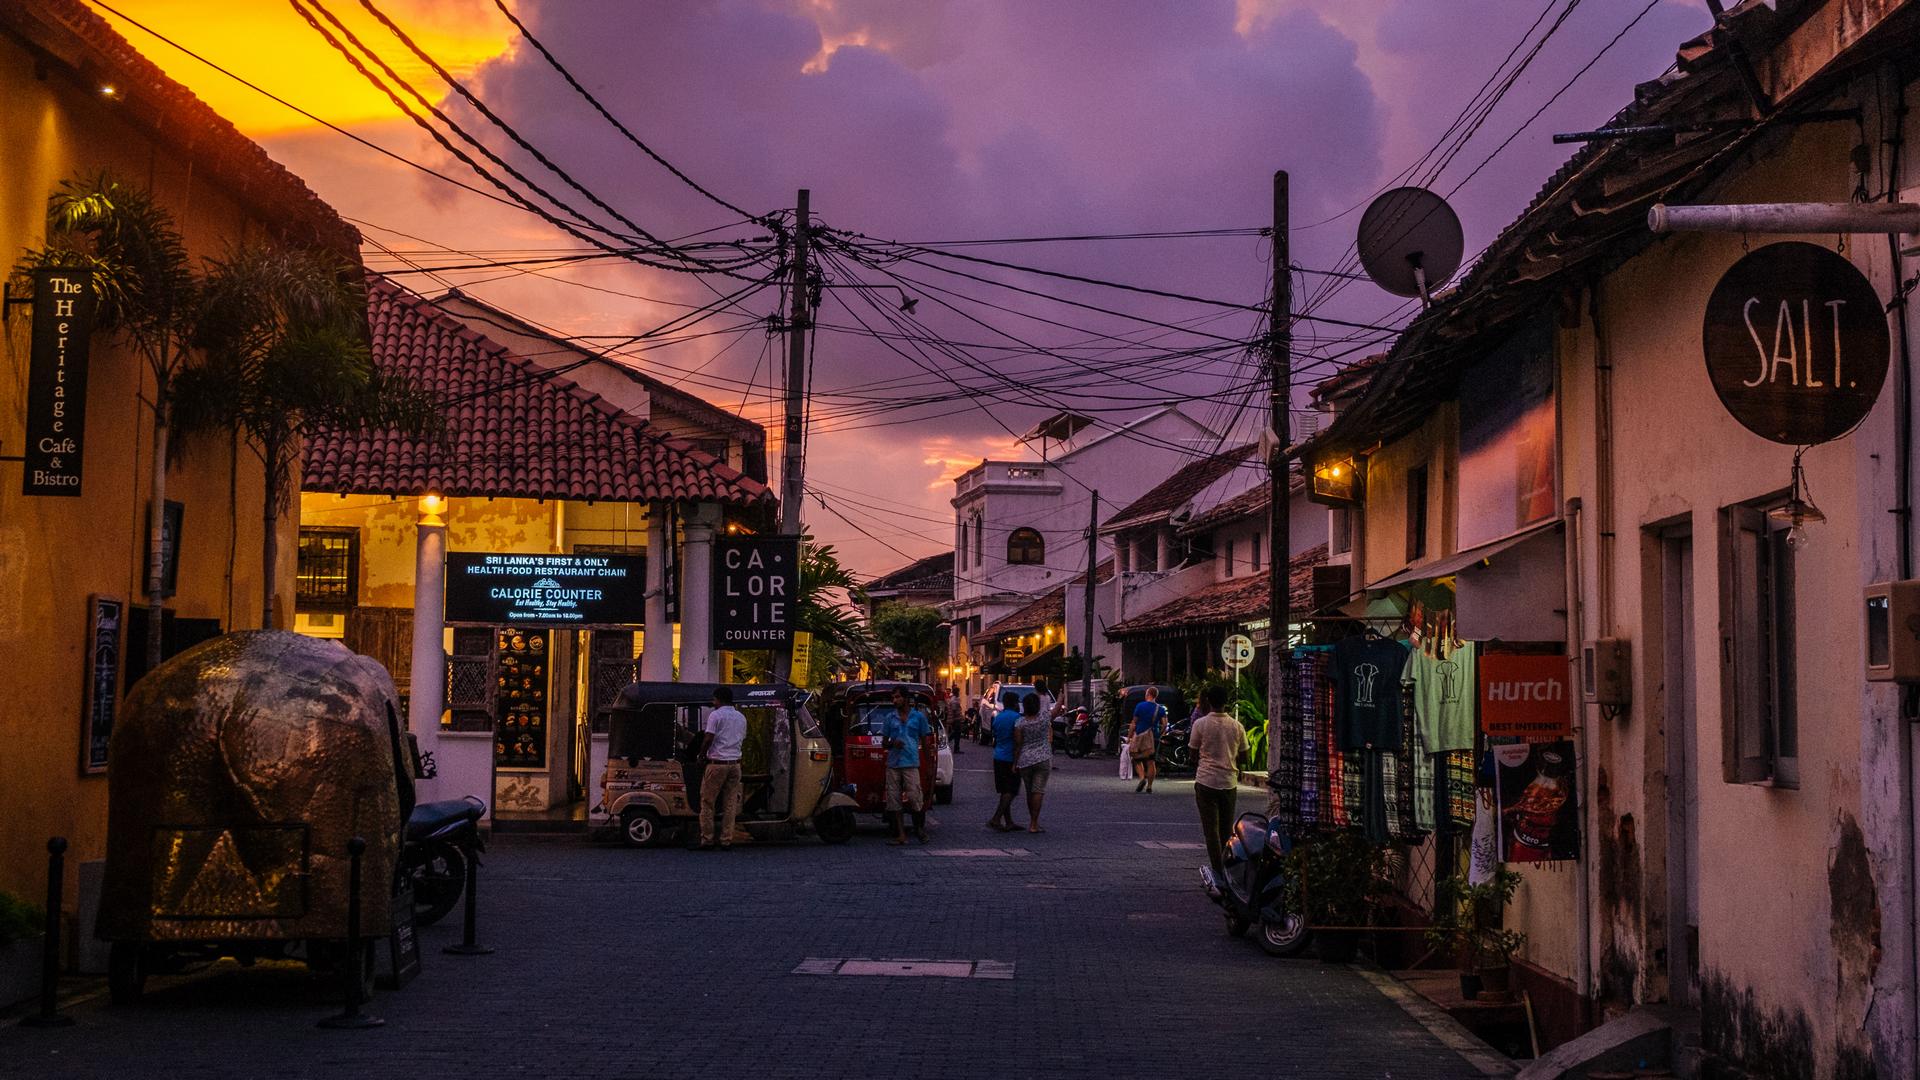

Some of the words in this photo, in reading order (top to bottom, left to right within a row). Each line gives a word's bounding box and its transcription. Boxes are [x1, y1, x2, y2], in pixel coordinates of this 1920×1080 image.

[50, 278, 82, 294] The
[1743, 297, 1856, 388] SALT.
[53, 300, 74, 433] Heritage
[39, 437, 76, 454] Café
[50, 456, 63, 469] &
[33, 470, 79, 487] Bistro
[486, 556, 502, 565] SRI
[504, 557, 544, 566] LANKA'S
[546, 558, 572, 566] FIRST
[574, 558, 582, 567] &
[583, 558, 609, 568] ONLY
[467, 566, 504, 575] HEALTH
[506, 567, 533, 576] FOOD
[534, 567, 596, 577] RESTAURANT
[598, 568, 627, 577] CHAIN
[491, 588, 543, 599] CALORIE
[545, 589, 602, 601] COUNTER
[515, 599, 525, 607] Eat
[545, 600, 558, 608] Stay
[509, 612, 523, 620] Open
[725, 630, 786, 640] COUNTER
[1489, 723, 1512, 731] BEST
[1515, 723, 1562, 731] INTERNET
[1521, 833, 1539, 844] zero
